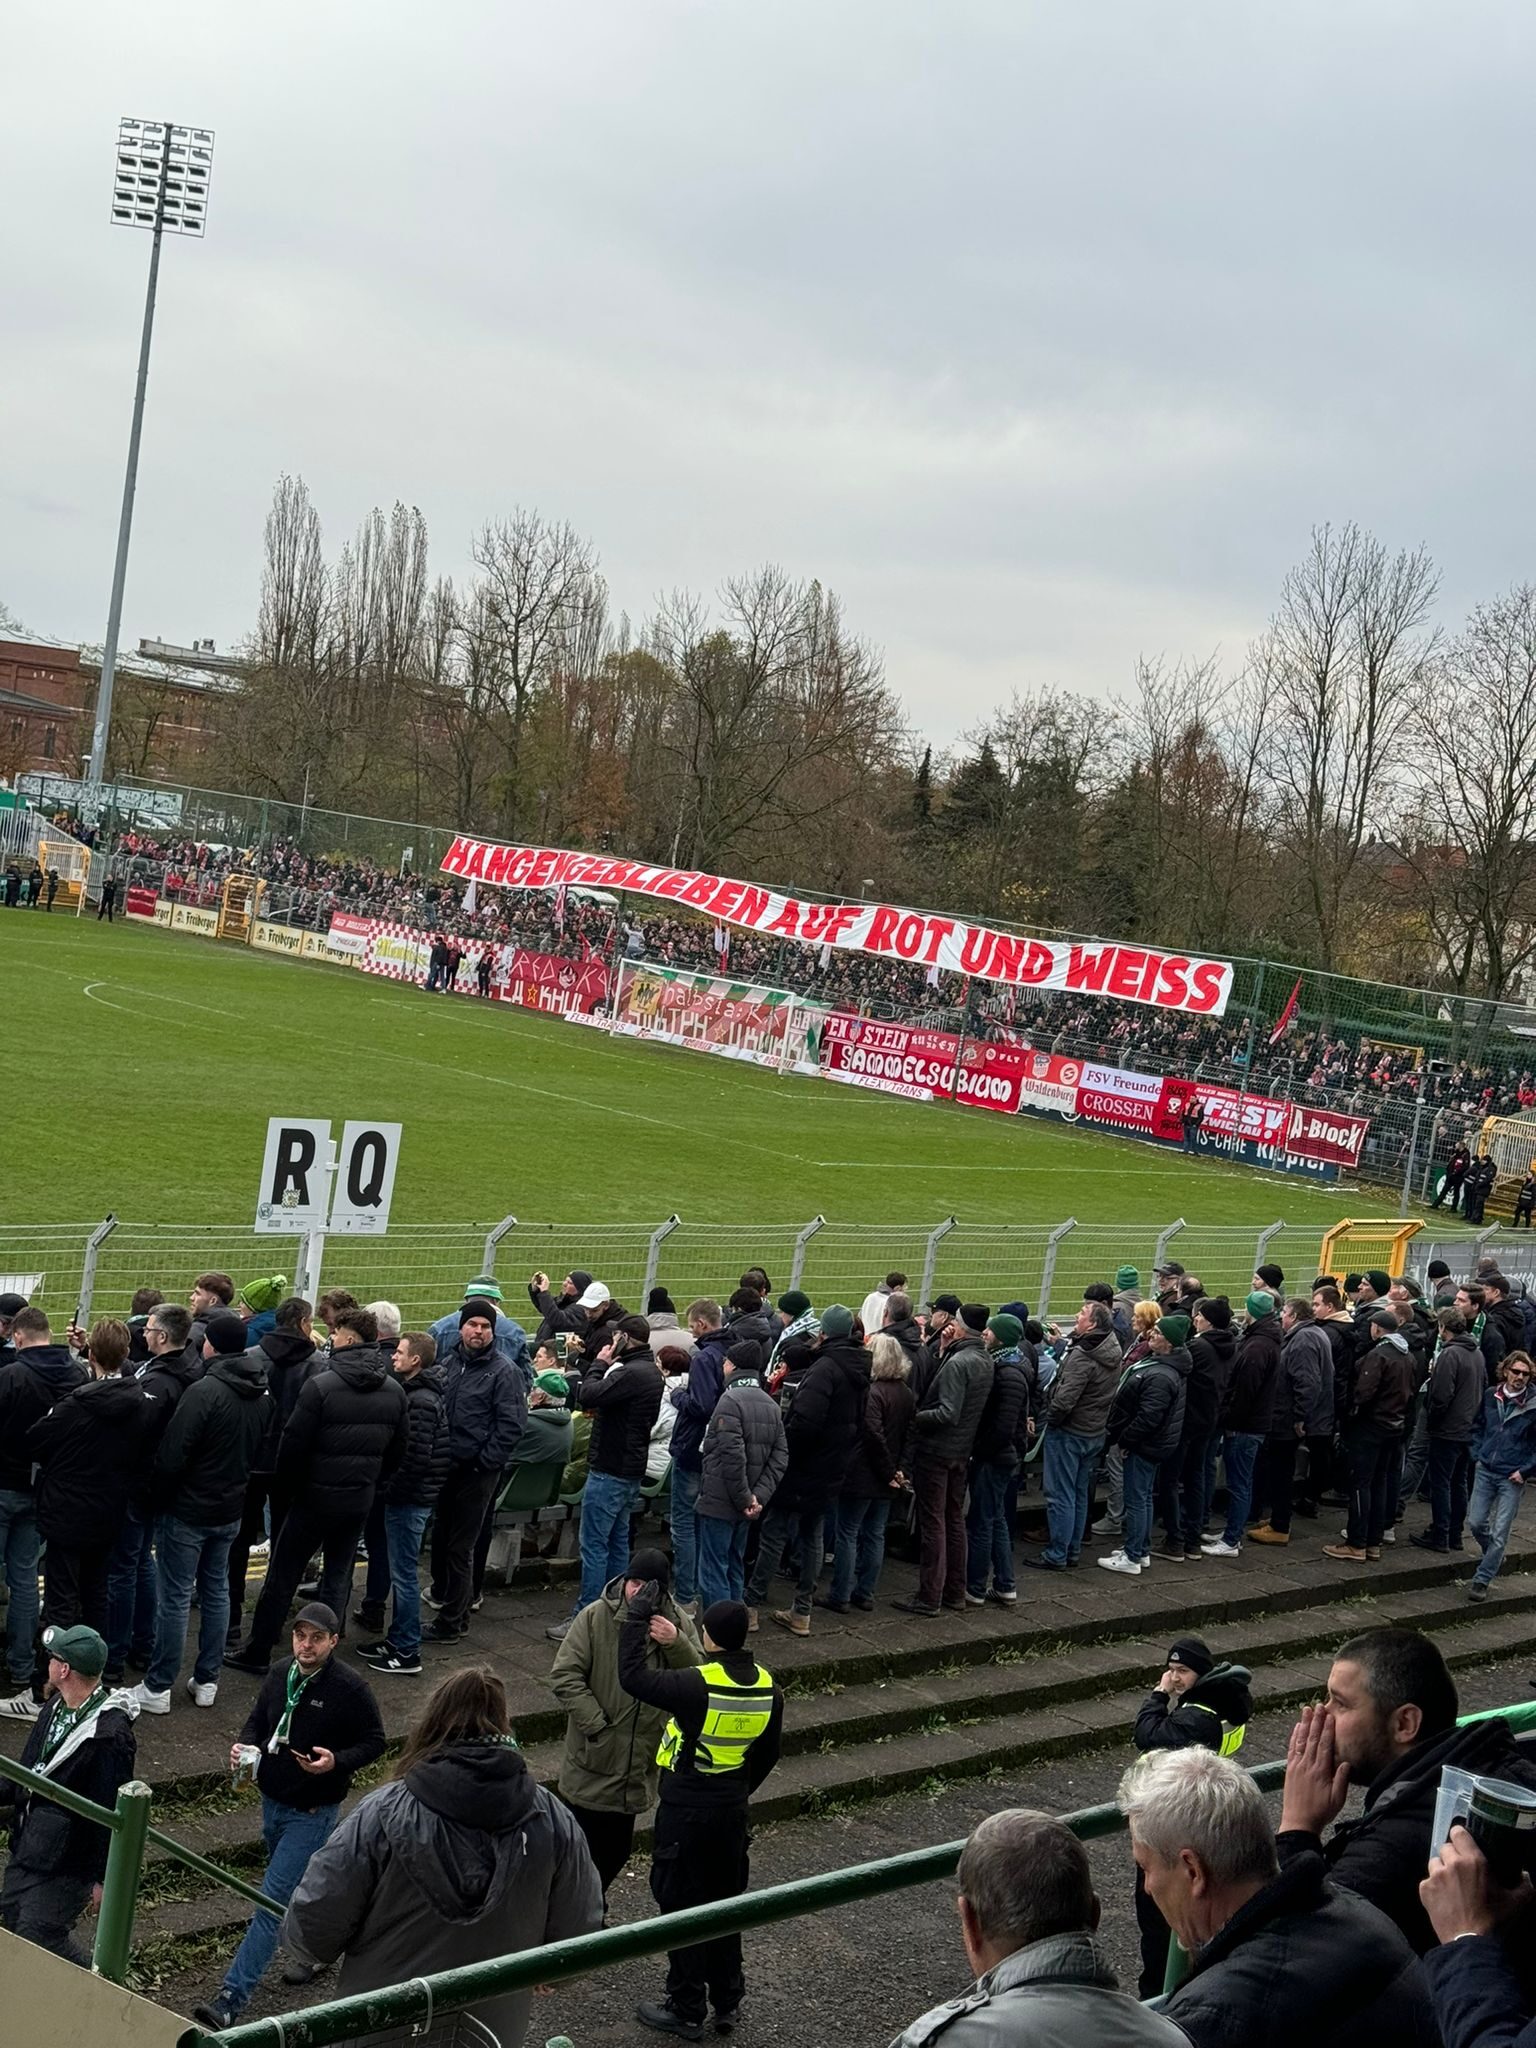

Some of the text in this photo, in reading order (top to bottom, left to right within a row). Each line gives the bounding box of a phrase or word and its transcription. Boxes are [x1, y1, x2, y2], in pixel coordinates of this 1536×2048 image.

[186, 911, 216, 931] Freiberger
[268, 928, 300, 949] Freiberger
[764, 900, 864, 943] AUF
[863, 907, 955, 964] ROT
[960, 928, 1054, 984] UND
[1066, 943, 1226, 1013] WEISS
[862, 1025, 910, 1050] STEIN
[1025, 1079, 1075, 1105] Waldenburg
[1086, 1070, 1111, 1084] FSV
[1113, 1077, 1162, 1095] Freunde
[1083, 1093, 1154, 1122] CROSSEN
[1289, 1110, 1362, 1154] A-Block
[271, 1128, 316, 1206] R
[347, 1130, 383, 1208] Q
